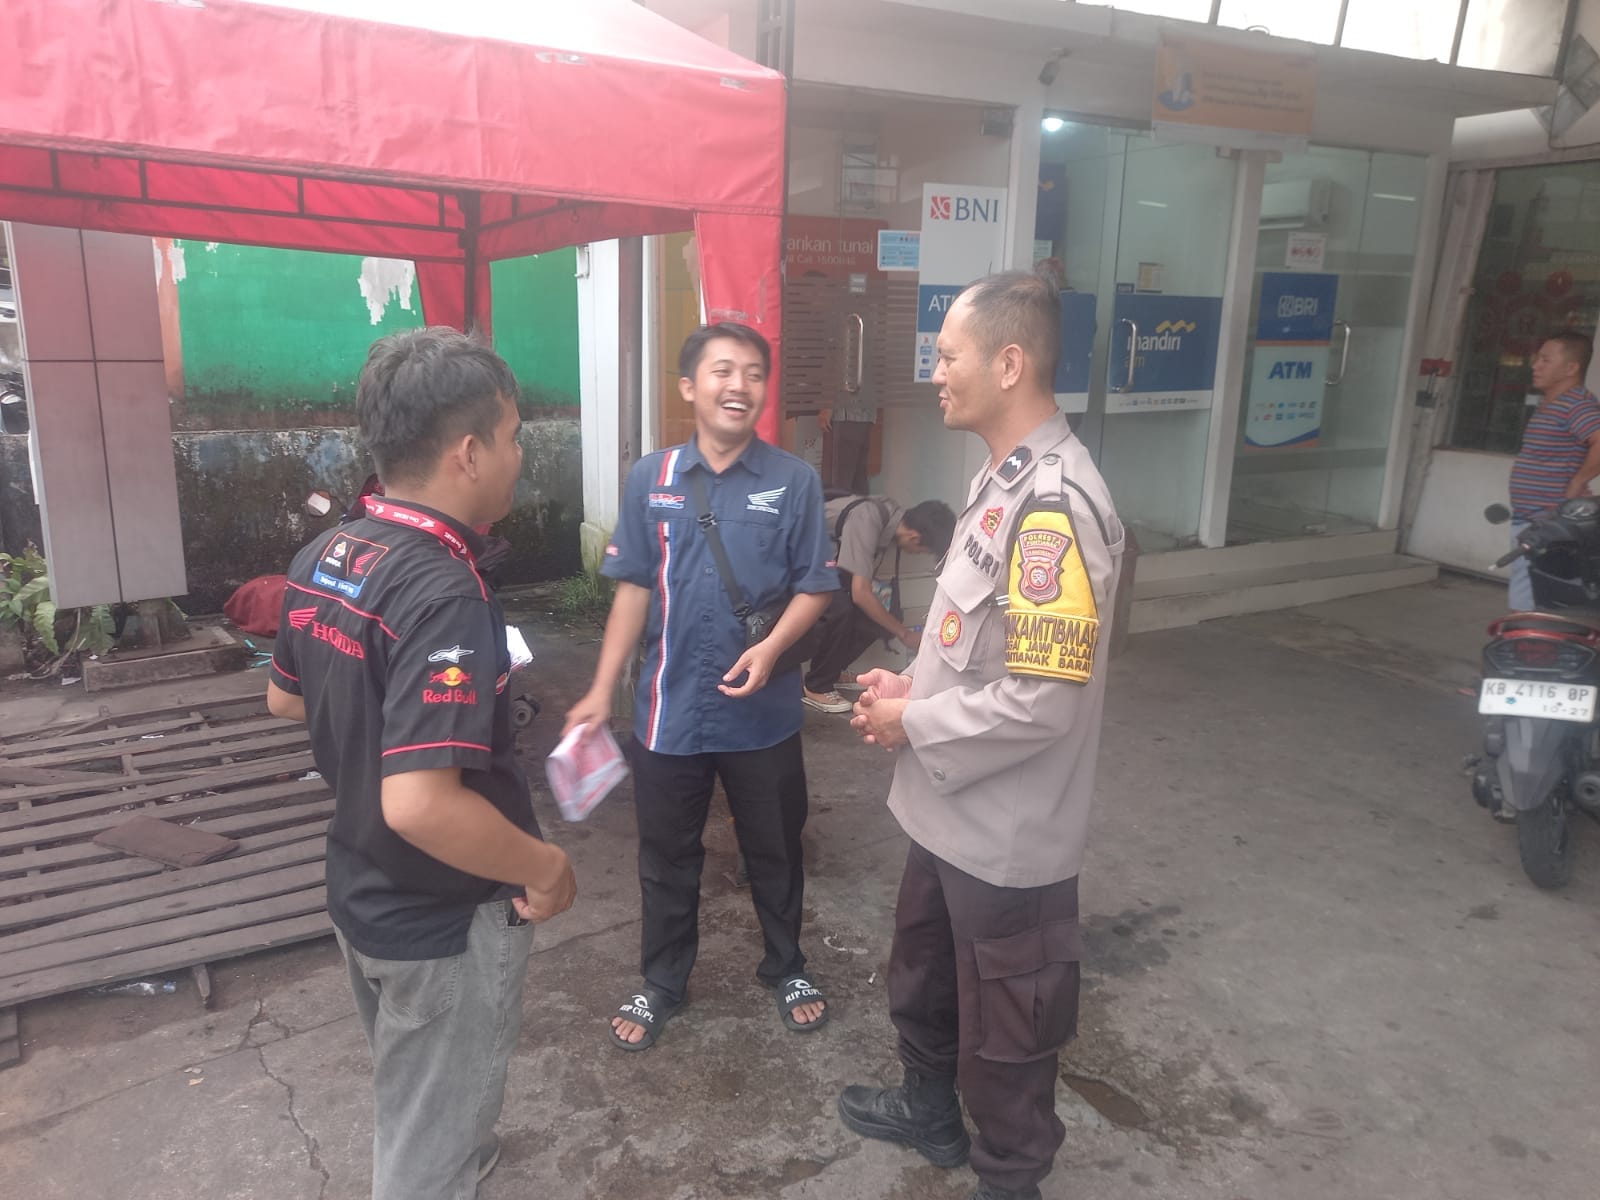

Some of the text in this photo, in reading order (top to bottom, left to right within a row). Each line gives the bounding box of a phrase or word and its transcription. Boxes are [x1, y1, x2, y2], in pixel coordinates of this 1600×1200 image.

[954, 197, 999, 223] BNI
[786, 235, 832, 252] arikan
[1293, 297, 1319, 317] BRI
[1124, 353, 1145, 369] am
[1267, 361, 1313, 380] ATM
[963, 533, 1000, 578] POLRI
[312, 620, 365, 660] HONDA
[1026, 641, 1053, 655] JAWI
[423, 689, 477, 705] Red Bull
[1485, 682, 1506, 697] KB
[1515, 683, 1557, 699] 4116
[784, 989, 800, 1004] RIP
